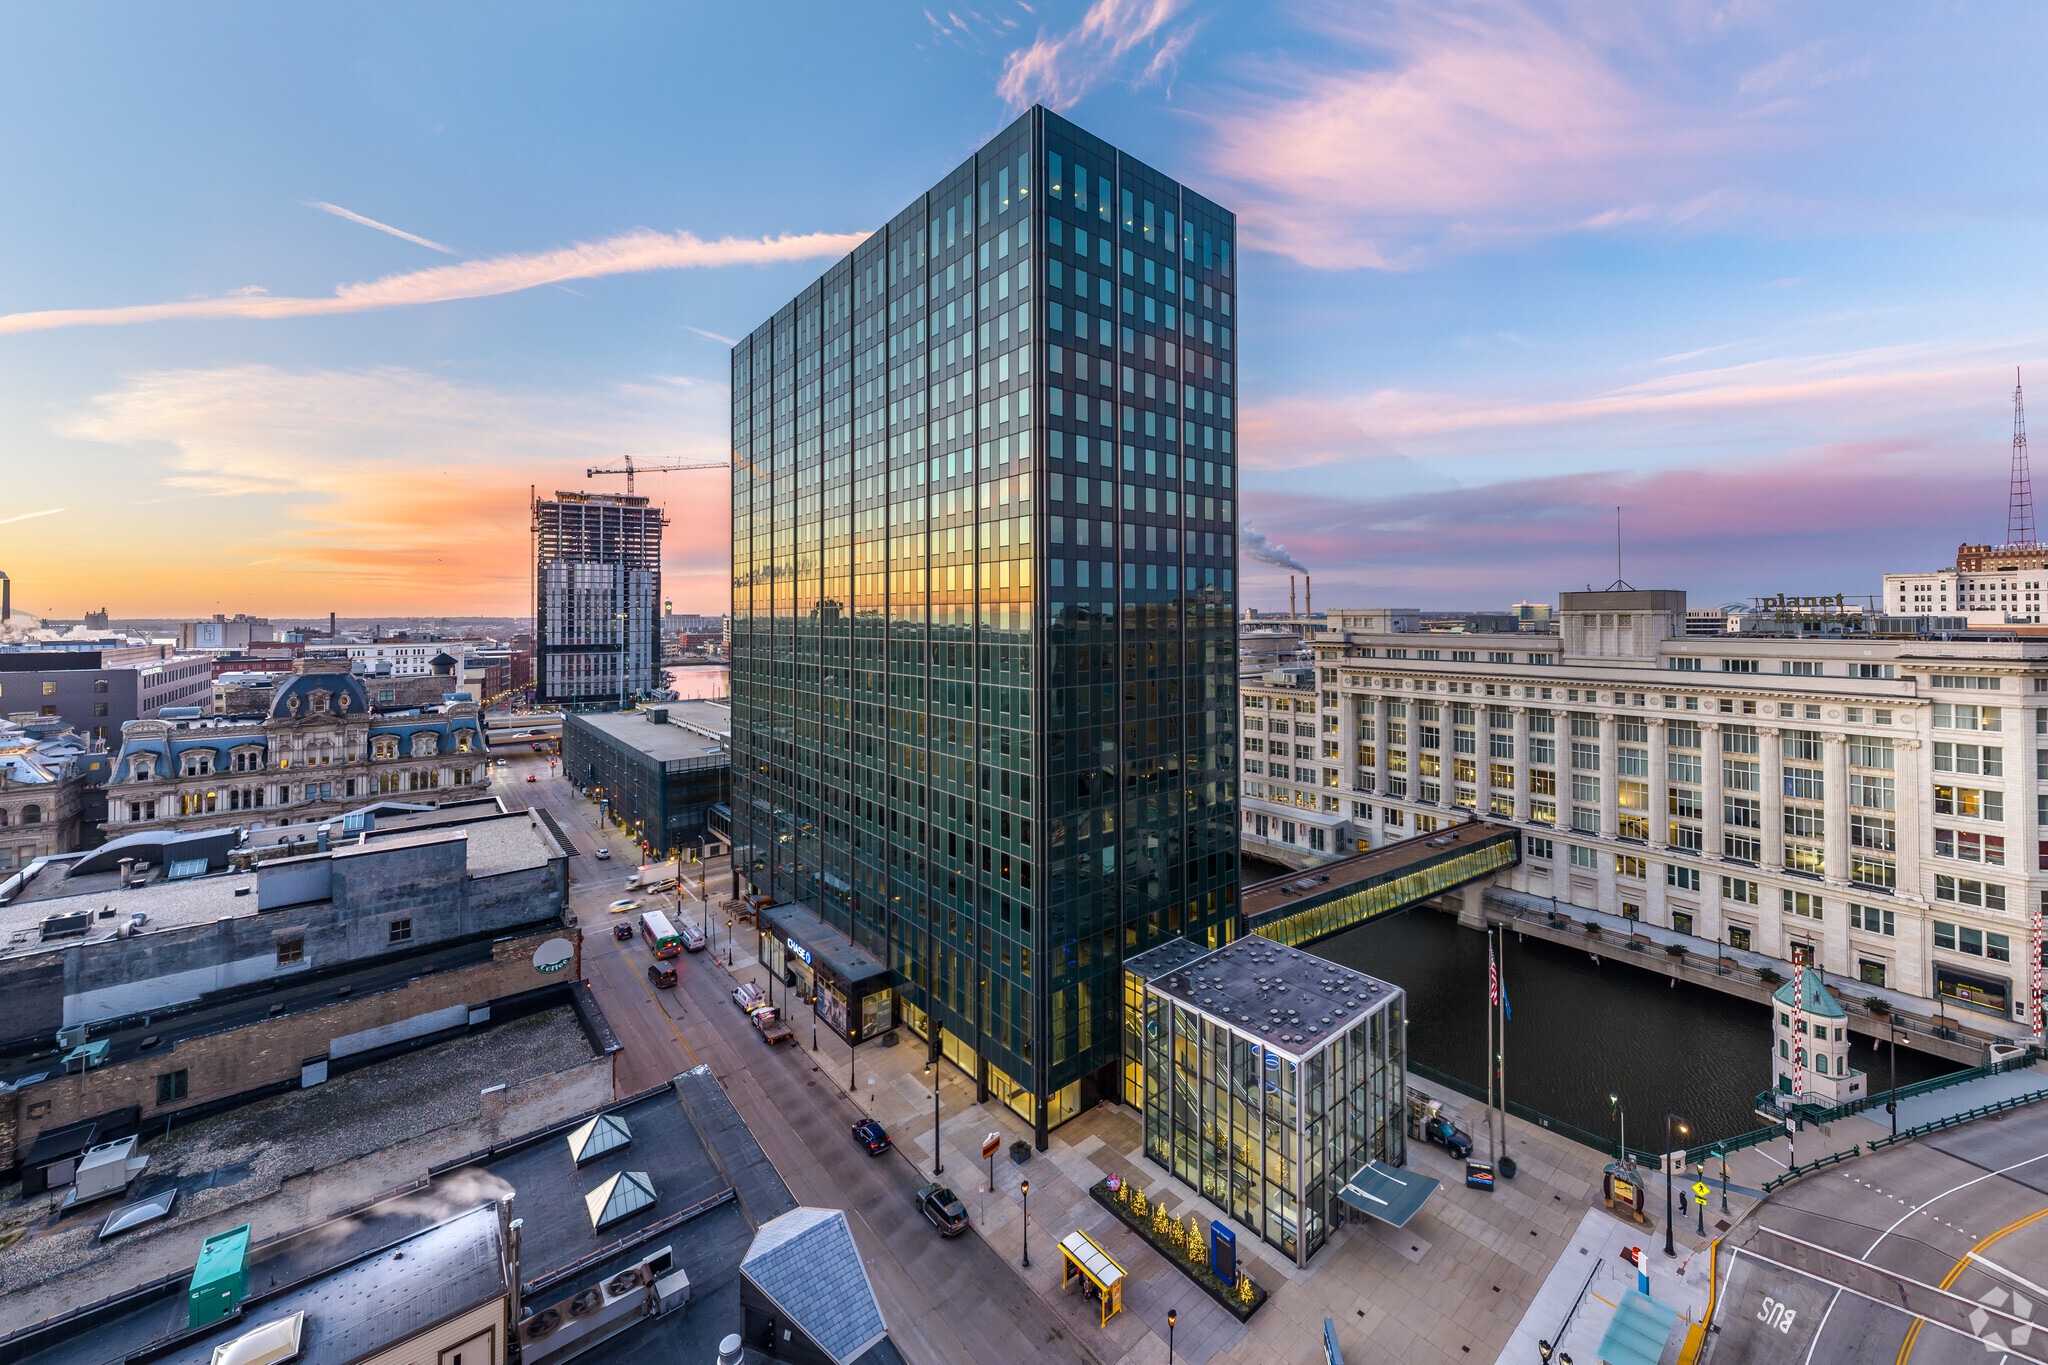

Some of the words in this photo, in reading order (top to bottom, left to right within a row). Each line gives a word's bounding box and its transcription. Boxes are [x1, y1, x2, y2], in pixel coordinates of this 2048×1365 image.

[1762, 593, 1845, 612] planet
[1774, 609, 1864, 624] fitness
[787, 937, 806, 960] CHASE
[540, 959, 569, 972] Coffee
[1756, 1296, 1797, 1334] BUS
